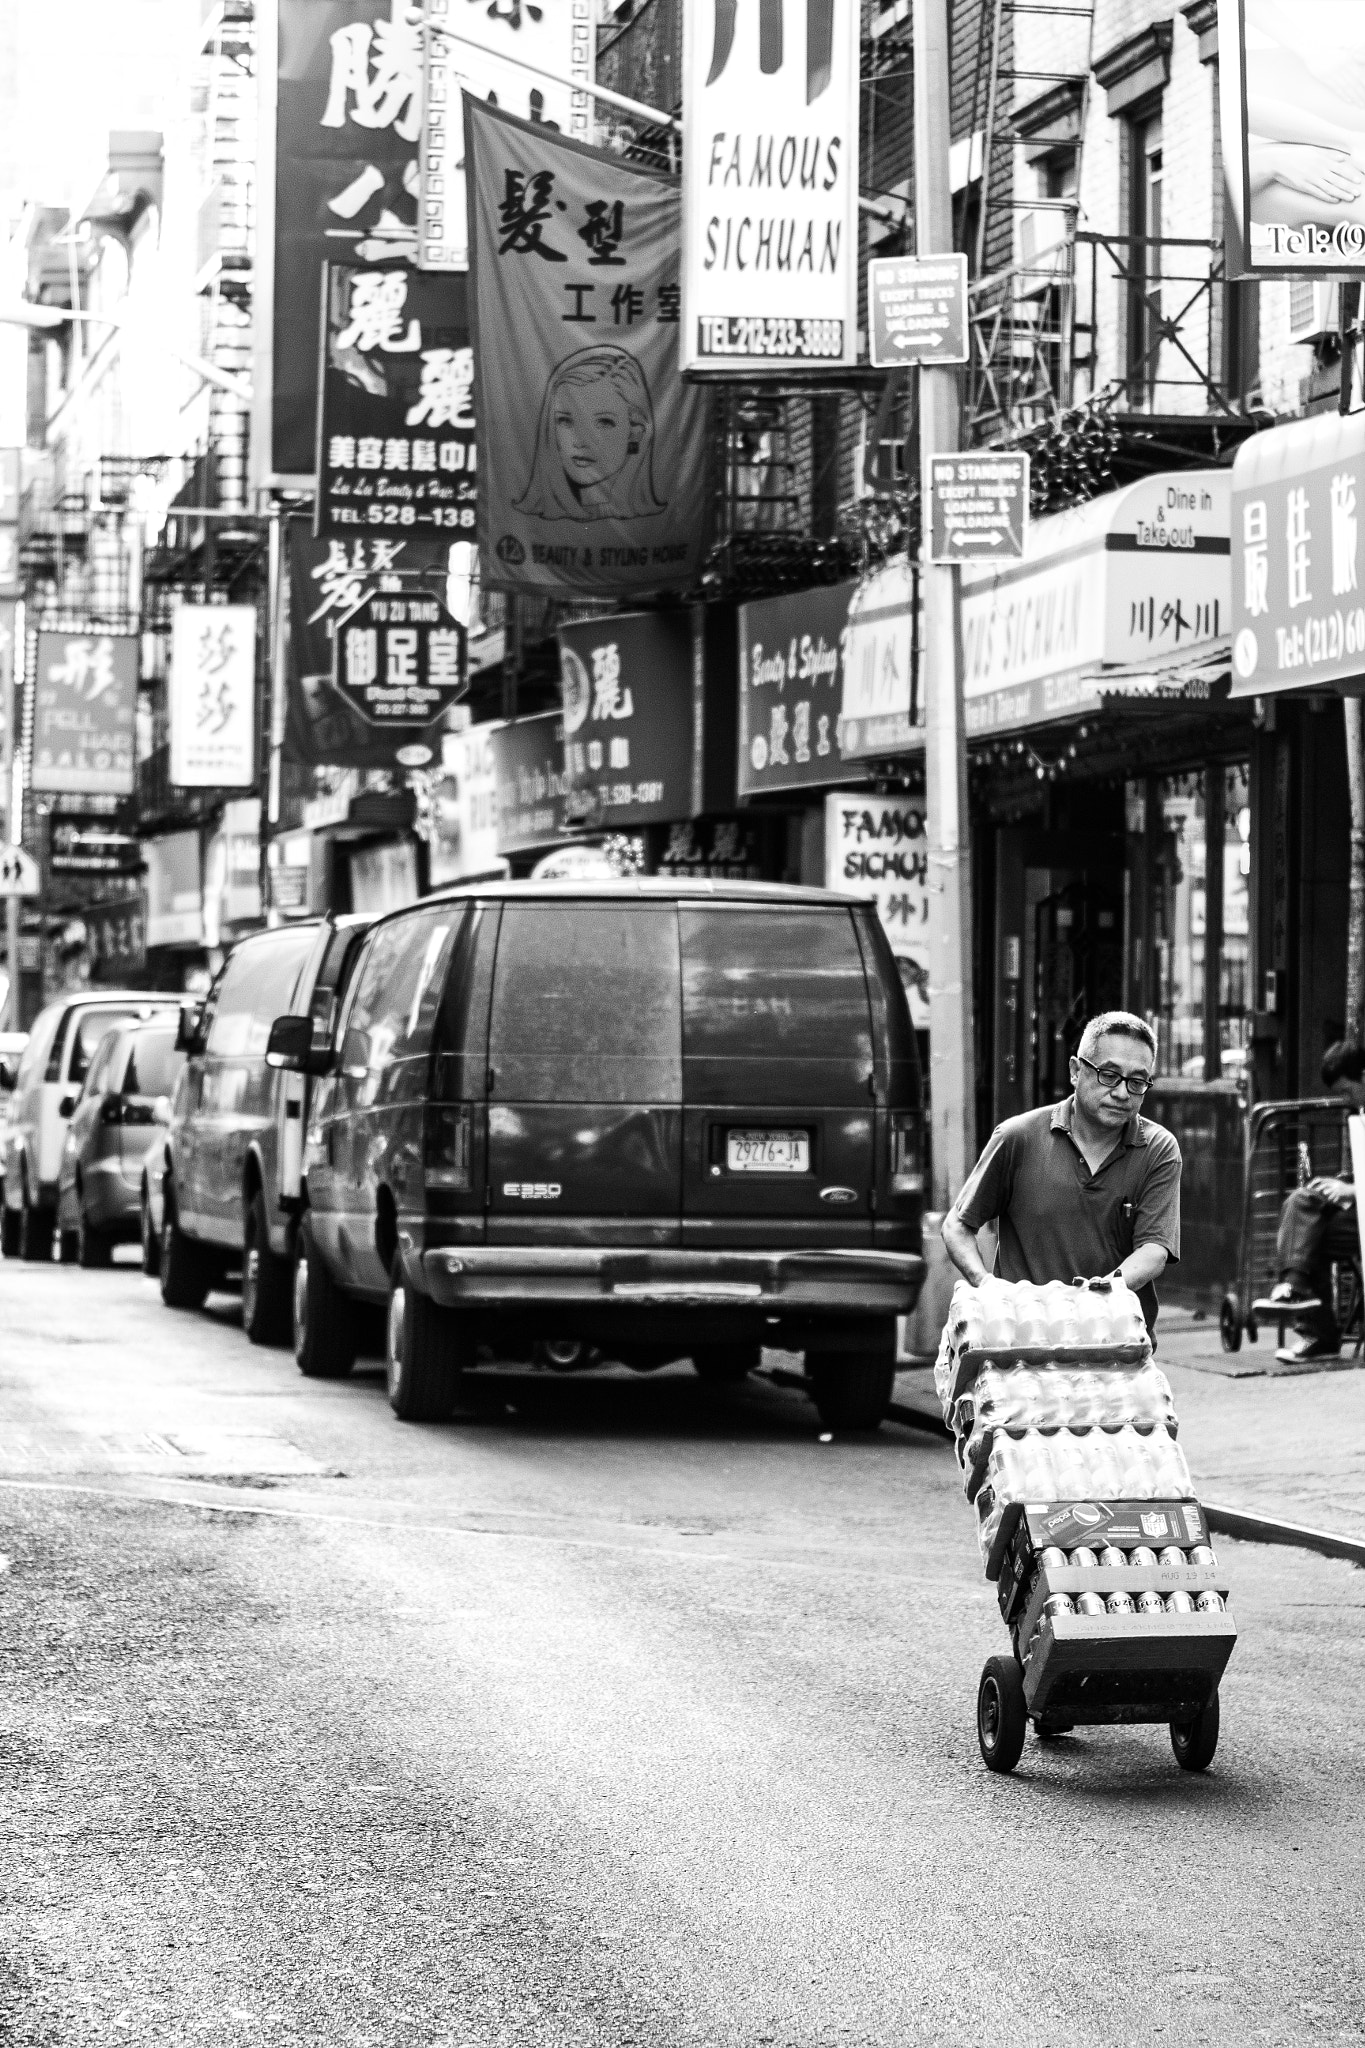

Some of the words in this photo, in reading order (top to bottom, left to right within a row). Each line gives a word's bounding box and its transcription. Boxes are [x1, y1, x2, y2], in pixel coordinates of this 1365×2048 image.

[708, 131, 842, 191] FAMOUS
[703, 215, 842, 274] SICHUAN
[876, 269, 895, 285] NO
[898, 264, 959, 284] STANDING
[879, 288, 915, 303] EXCEPT
[917, 285, 955, 300] TRUCKS
[562, 282, 680, 325] 工作室
[884, 301, 934, 317] LOADING
[886, 314, 950, 332] UNLOADING
[934, 464, 954, 481] NO
[957, 462, 1021, 480] STANDING
[938, 484, 976, 499] EXCEPT
[978, 483, 1017, 498] TRUCKS
[1167, 487, 1196, 510] Dine
[1201, 488, 1213, 511] in
[944, 499, 995, 514] LOADING
[999, 498, 1010, 513] &
[1156, 505, 1165, 522] &
[944, 513, 1011, 529] UNLOADING
[1137, 520, 1167, 546] Take
[1170, 525, 1194, 546] out
[600, 547, 648, 567] STYLING
[370, 601, 388, 622] YU
[390, 601, 406, 622] ZU
[409, 601, 440, 623] TANG
[1130, 596, 1219, 645] 川外川
[1047, 1511, 1072, 1529] pepsi
[1146, 1524, 1166, 1532] NFL
[1161, 1571, 1180, 1580] AUG
